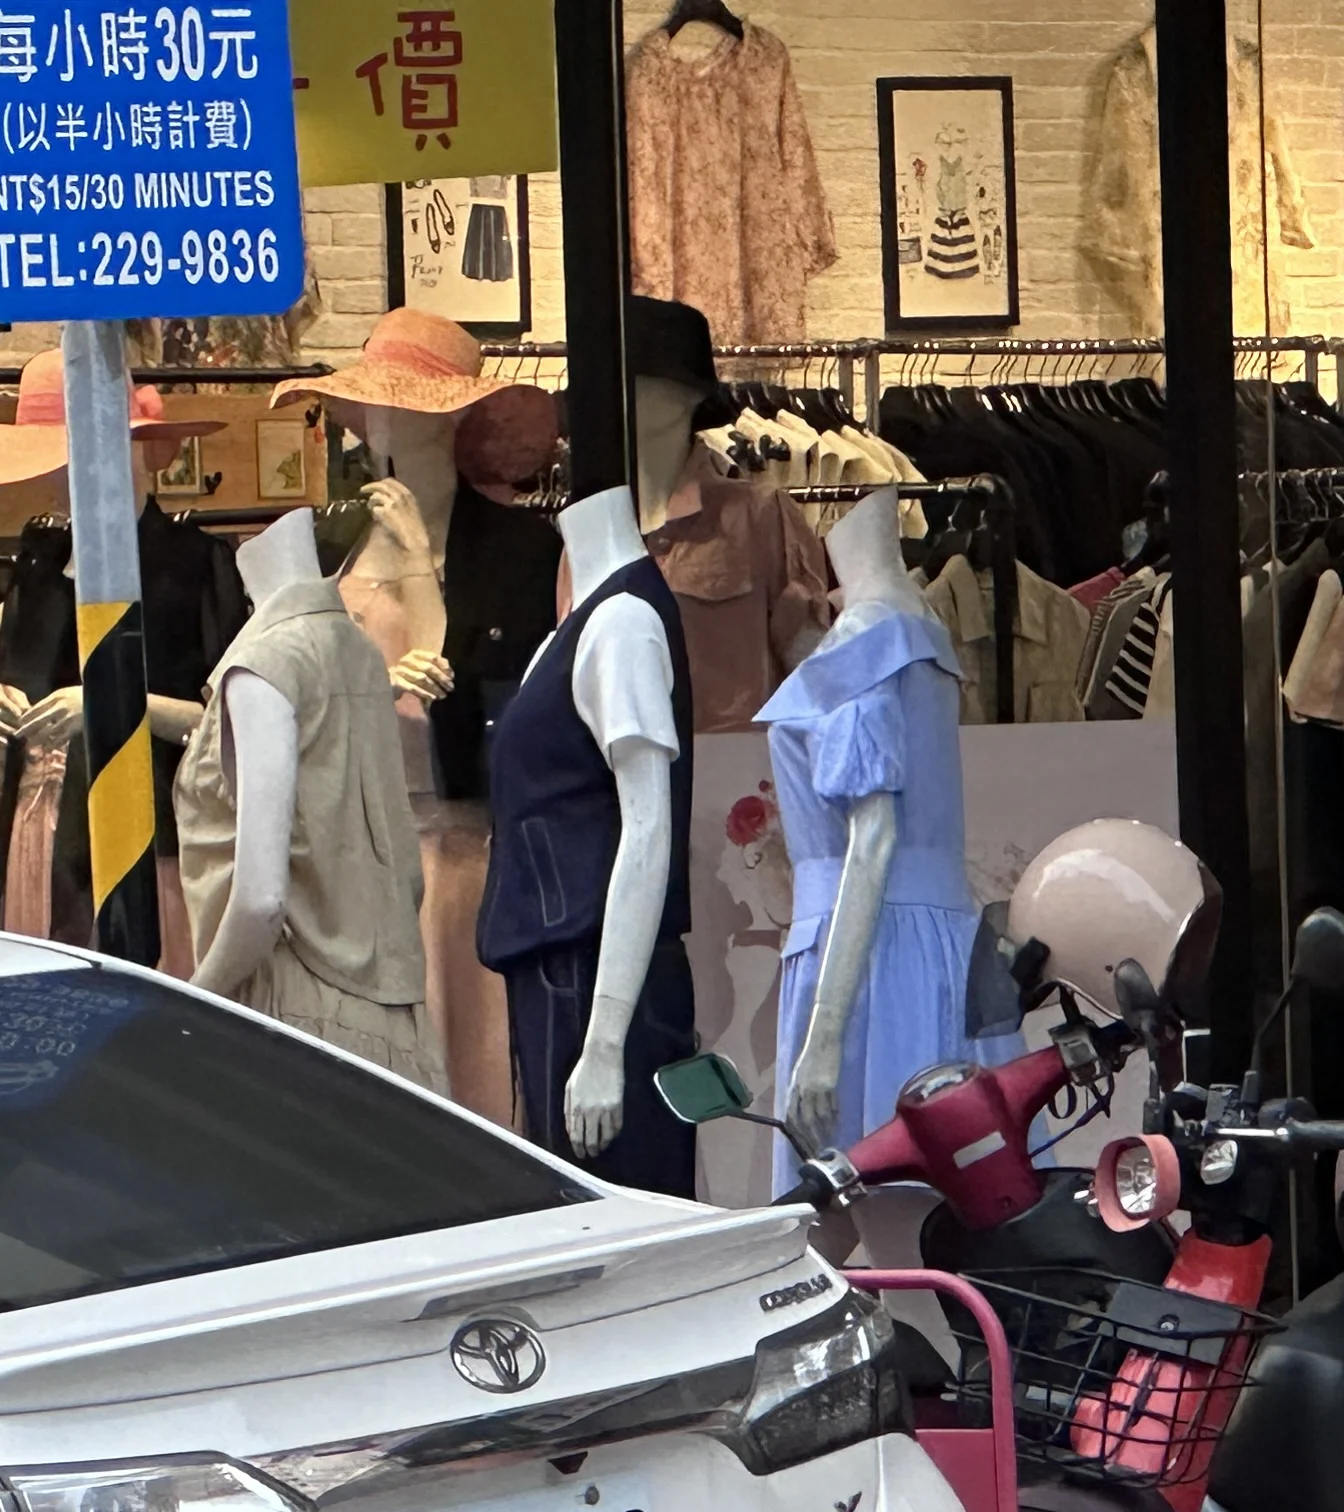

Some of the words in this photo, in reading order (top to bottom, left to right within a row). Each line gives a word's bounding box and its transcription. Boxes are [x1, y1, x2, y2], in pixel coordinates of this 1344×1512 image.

[2, 98, 252, 154] (以半小時計費)
[134, 170, 276, 208] MINUTES
